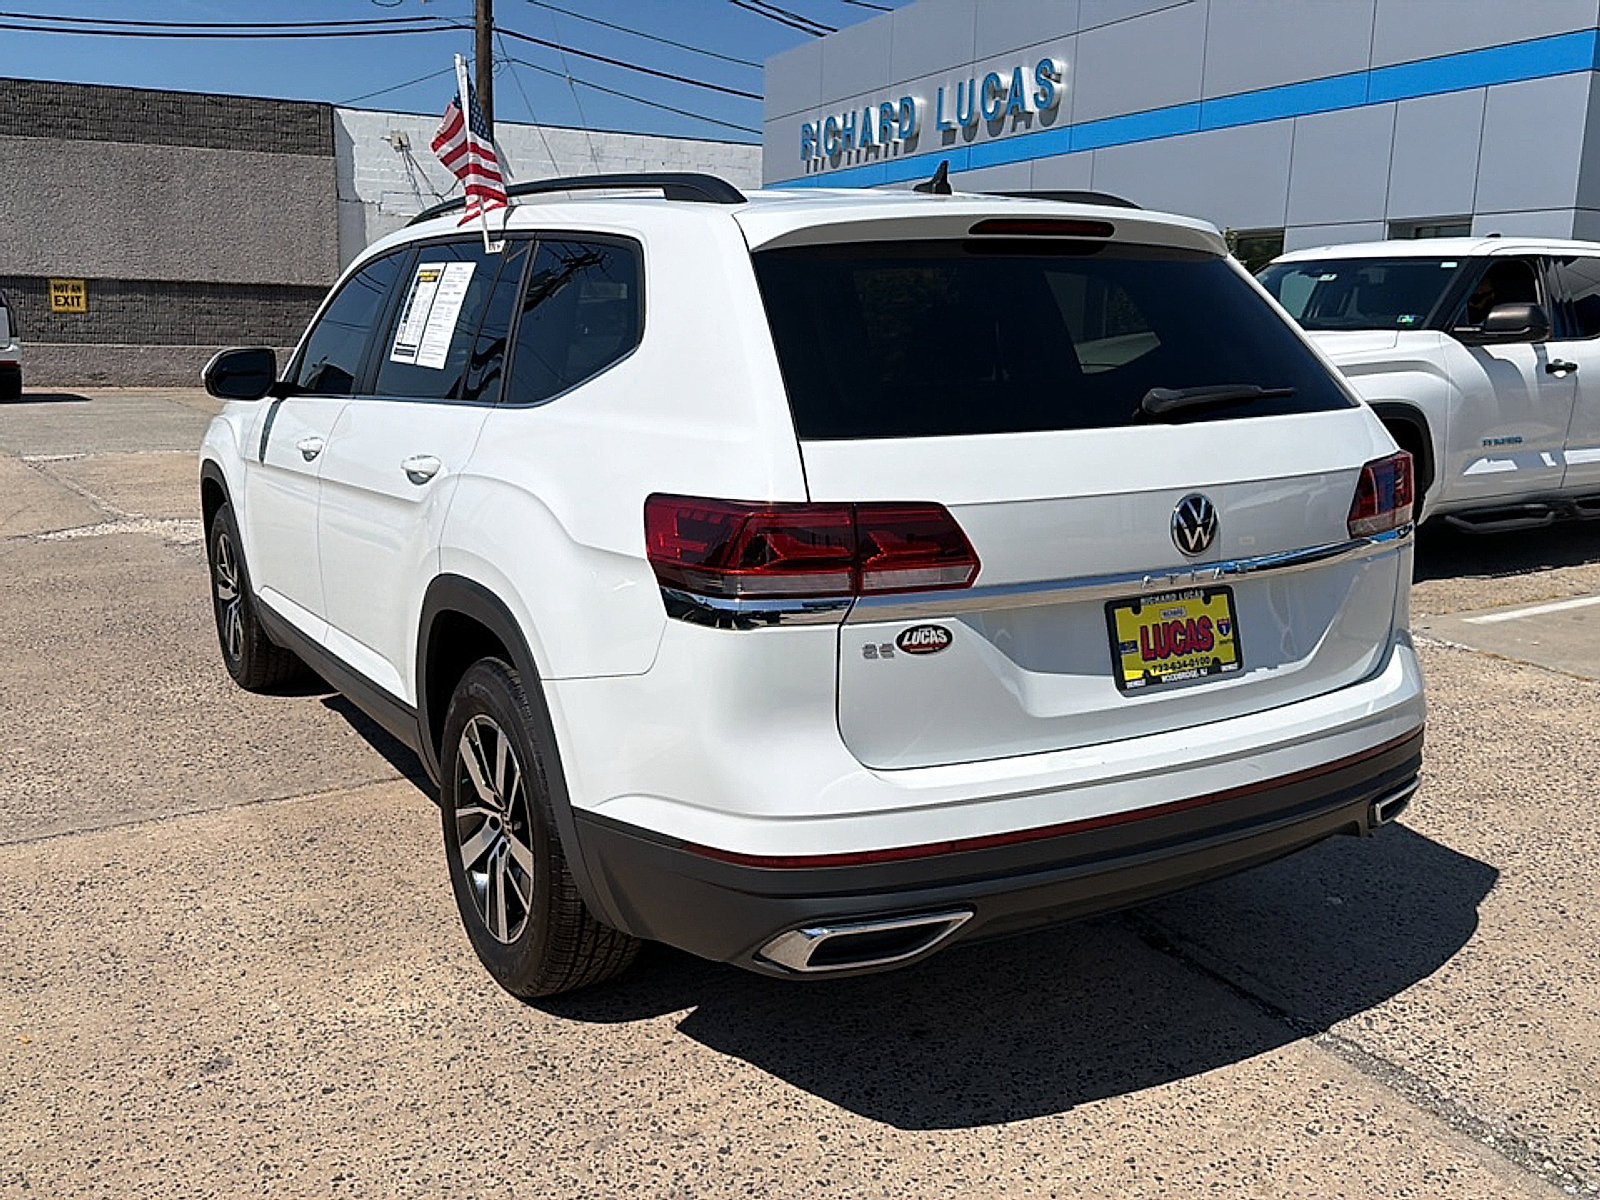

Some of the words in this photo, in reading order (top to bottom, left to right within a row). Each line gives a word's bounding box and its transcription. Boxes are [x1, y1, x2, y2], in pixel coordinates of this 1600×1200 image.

[799, 95, 916, 161] RICHARD
[936, 58, 1057, 131] LUCAS
[53, 284, 69, 293] NOT
[54, 295, 81, 307] EXIT
[901, 628, 948, 646] LUCAS
[1140, 615, 1215, 662] LUCAS
